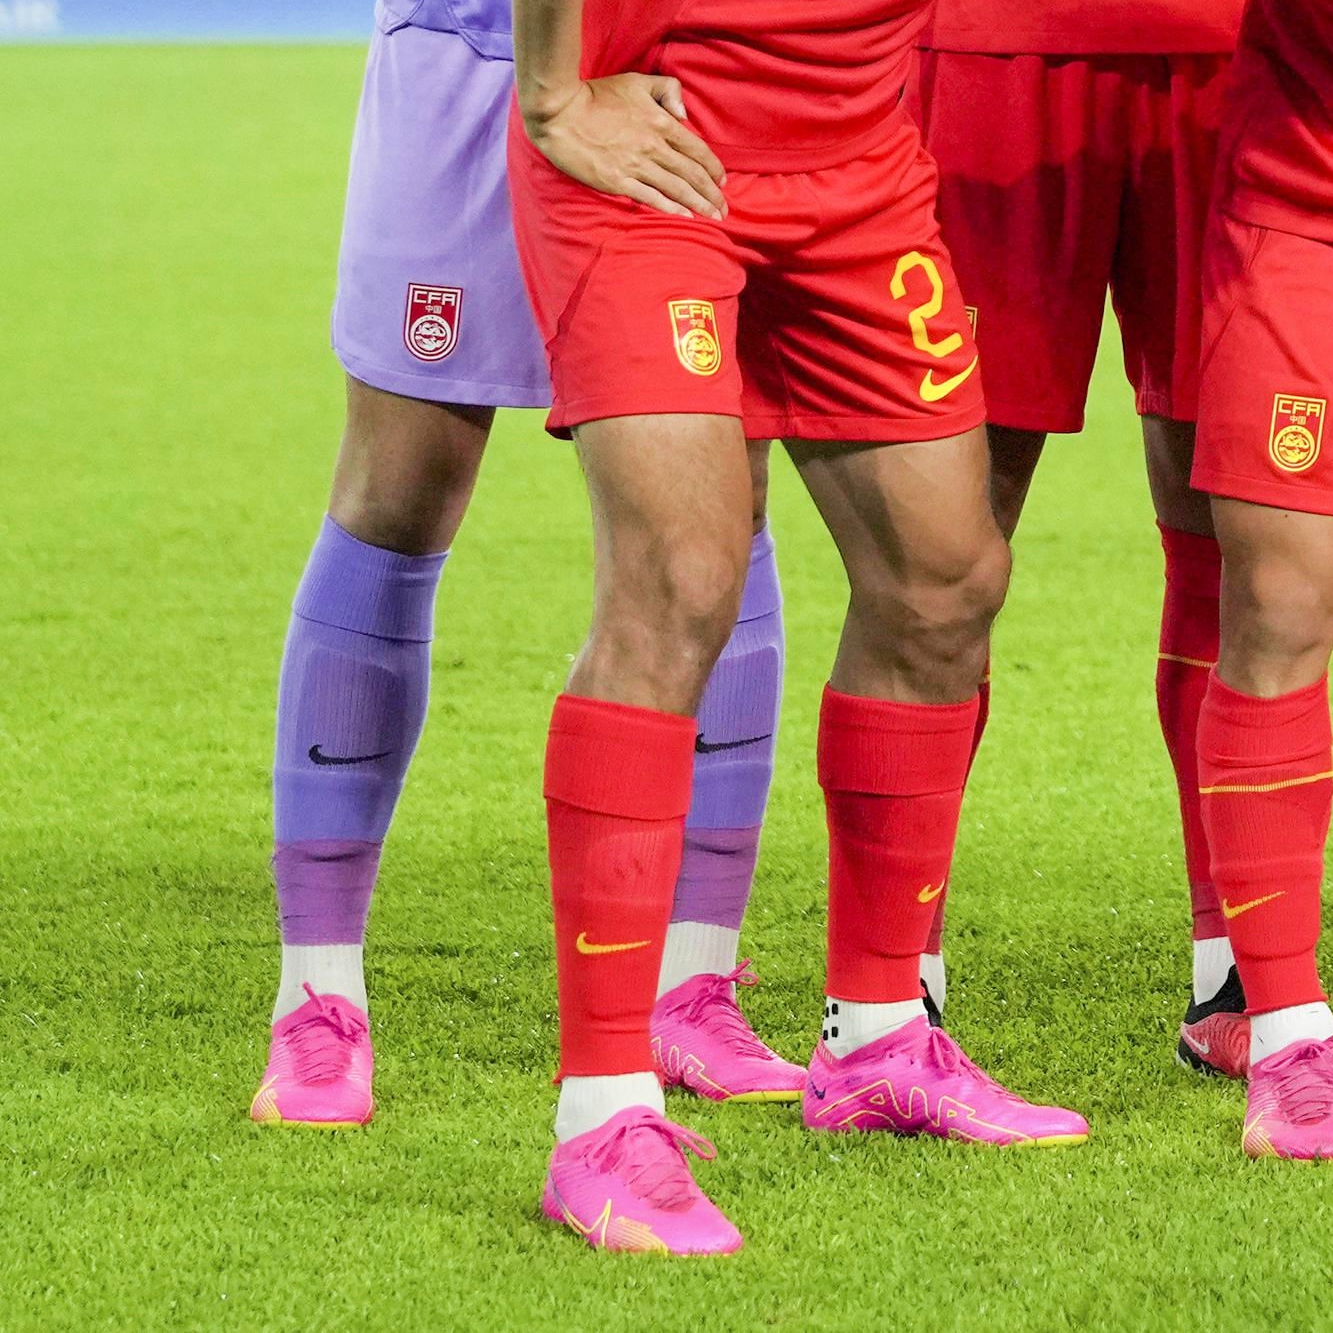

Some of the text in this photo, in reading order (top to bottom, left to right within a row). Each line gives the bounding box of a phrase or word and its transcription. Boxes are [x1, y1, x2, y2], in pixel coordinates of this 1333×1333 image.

[413, 290, 457, 306] CFA
[889, 251, 963, 359] 2
[675, 305, 712, 320] CFA
[1278, 399, 1321, 417] CFA
[814, 1079, 1036, 1141] AIR
